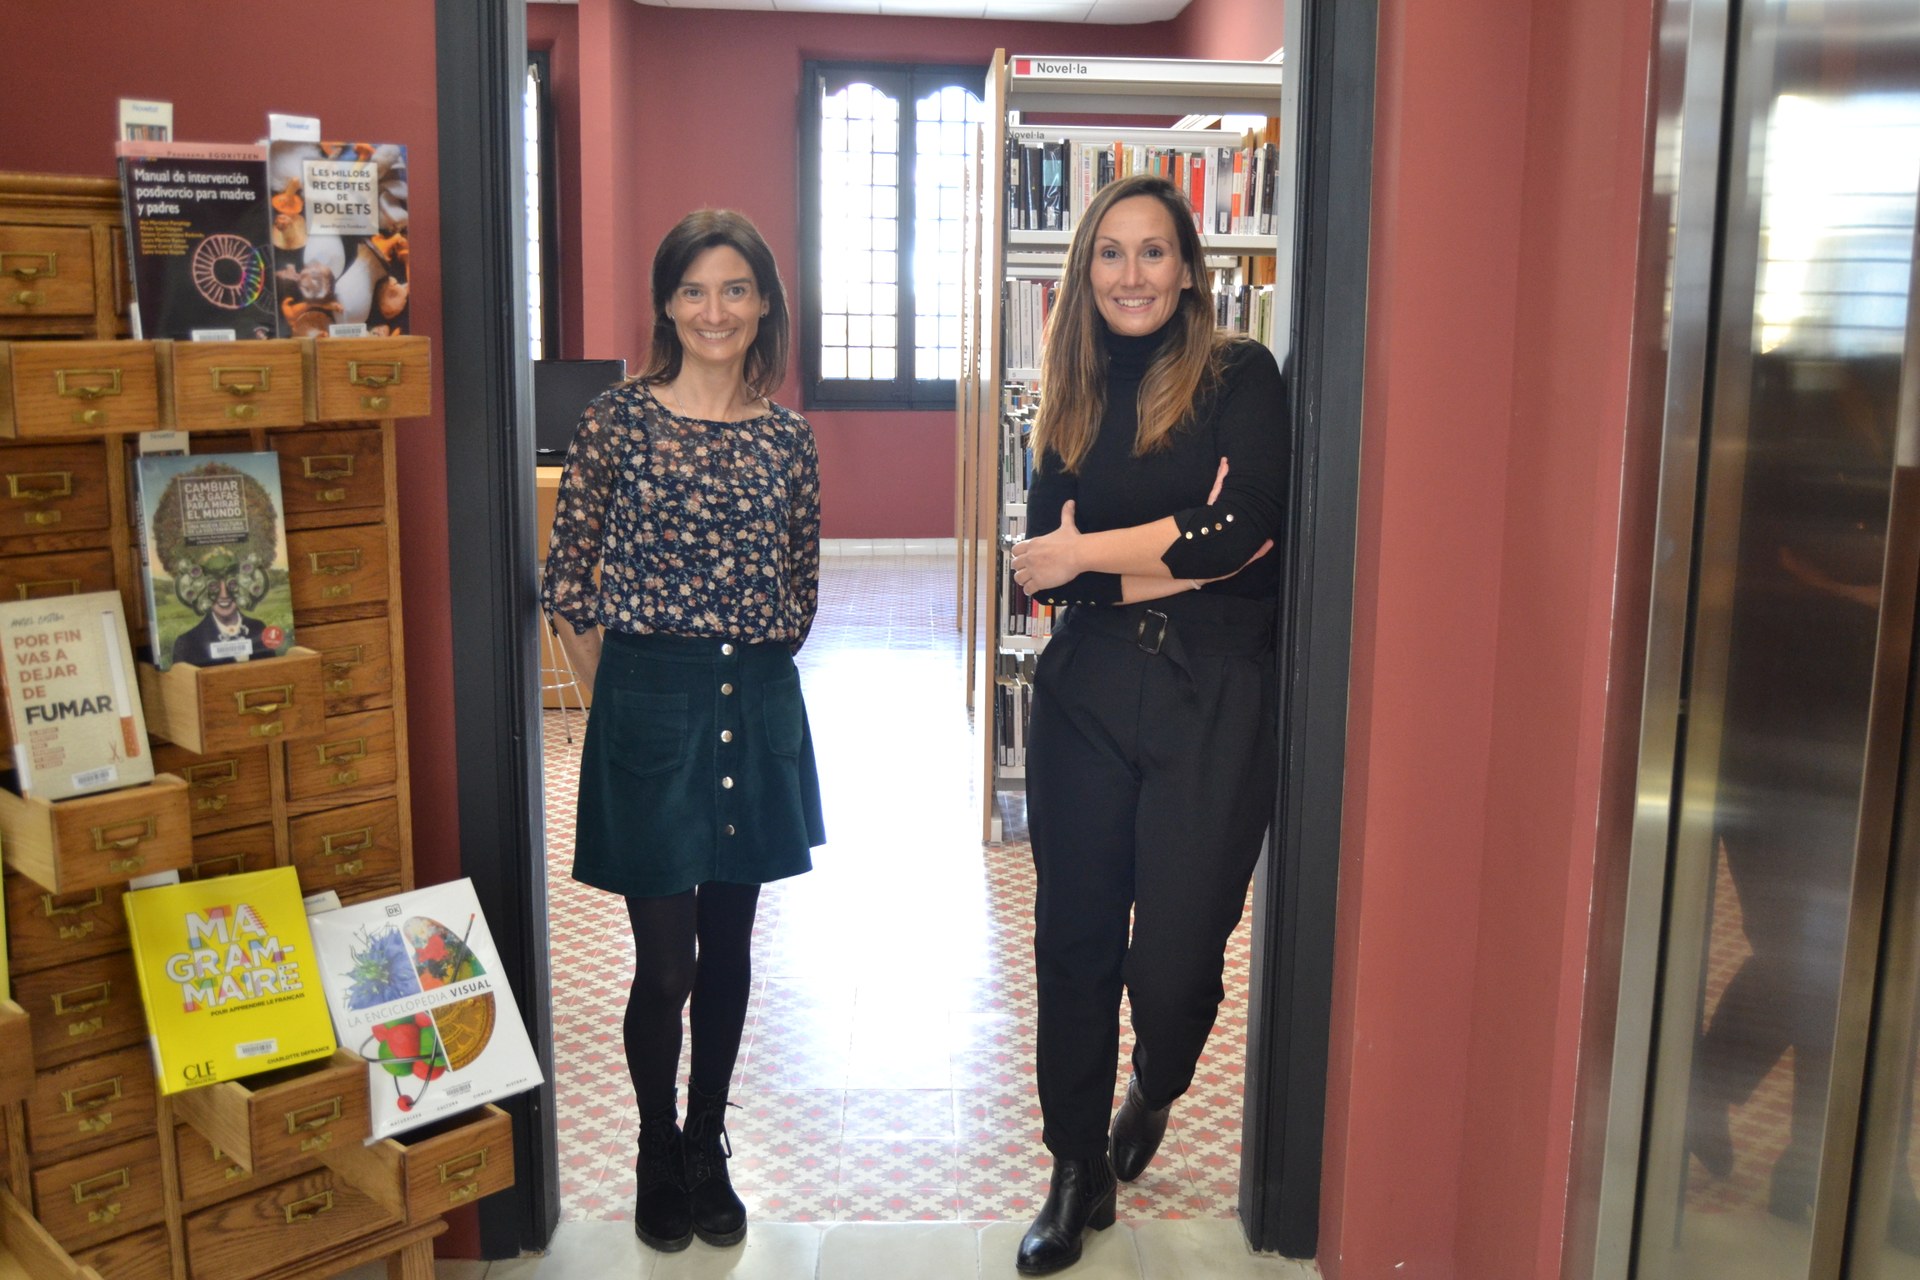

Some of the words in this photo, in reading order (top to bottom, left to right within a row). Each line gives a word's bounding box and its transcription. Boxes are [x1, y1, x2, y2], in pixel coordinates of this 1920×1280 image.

[1037, 62, 1087, 74] Novel·la
[134, 169, 170, 182] Manual
[173, 171, 185, 183] de
[188, 172, 249, 184] intervención
[332, 169, 370, 178] MILLORS
[136, 185, 193, 200] posdivorcio
[196, 189, 217, 202] para
[220, 188, 256, 201] madres
[312, 181, 371, 191] RECEPTES
[337, 193, 348, 201] DE
[137, 203, 144, 216] y
[147, 201, 180, 216] padres
[313, 203, 371, 215] BOLETS
[184, 480, 239, 493] CAMBIAR
[185, 493, 205, 502] LAS
[207, 491, 240, 501] GAFAS
[187, 501, 209, 510] PARA
[212, 500, 240, 508] MIRAR
[187, 510, 201, 520] EL
[203, 507, 242, 519] MUNDO
[14, 633, 50, 649] POR
[53, 629, 82, 644] FIN
[16, 650, 51, 665] VAS
[55, 648, 68, 661] A
[19, 664, 78, 683] DEJAR
[22, 685, 47, 700] DE
[25, 695, 113, 725] FUMAR
[387, 905, 401, 916] DK
[184, 903, 268, 950] MA
[182, 962, 303, 1011] MAIRE
[211, 1007, 229, 1017] POUR
[229, 1002, 265, 1014] APPRENDRE
[347, 1016, 362, 1028] LA
[364, 991, 448, 1023] ENCICLOPEDIA
[449, 979, 492, 998] VISUAL
[267, 1052, 300, 1065] CHARLOTTE
[183, 1060, 215, 1081] CLE
